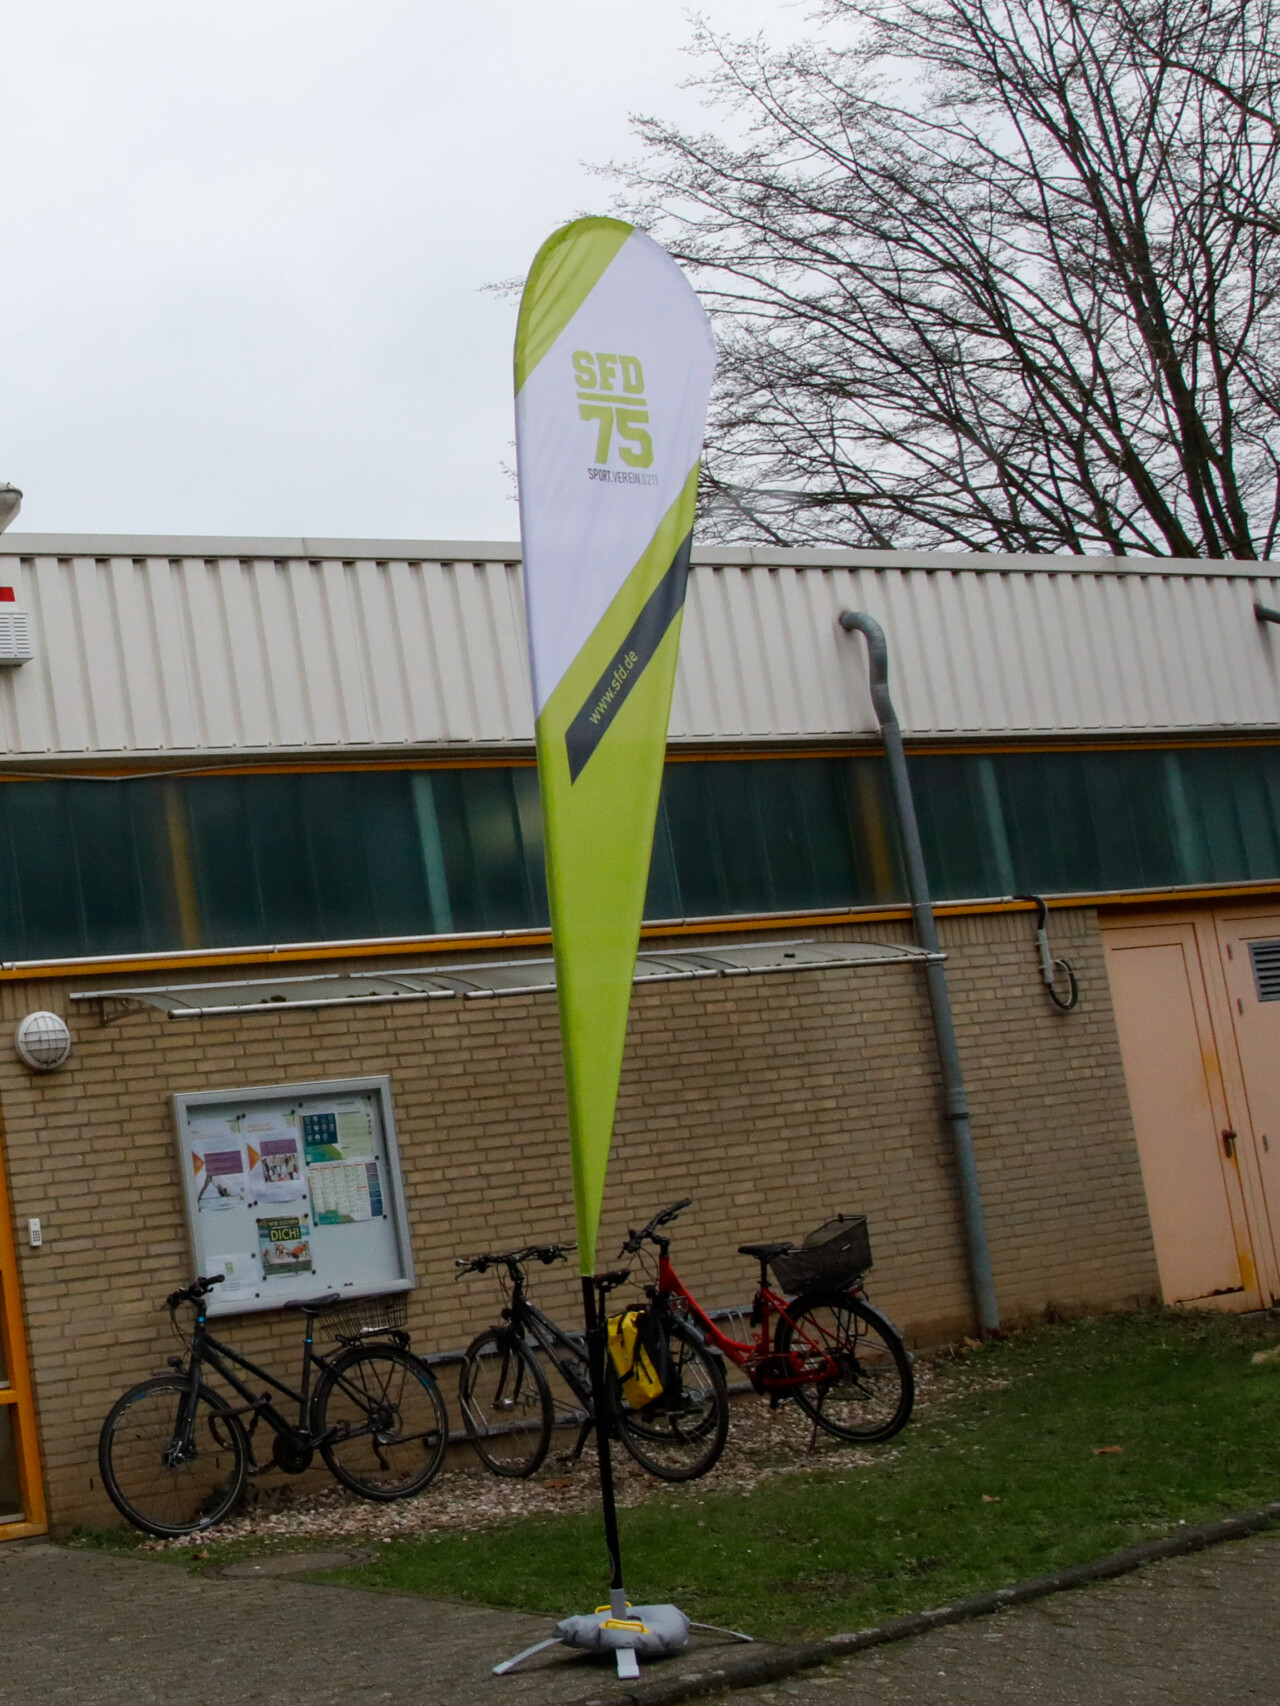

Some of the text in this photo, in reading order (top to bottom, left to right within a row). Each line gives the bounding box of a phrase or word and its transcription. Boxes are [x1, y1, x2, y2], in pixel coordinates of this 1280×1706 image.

[572, 350, 645, 395] SFD
[578, 403, 655, 469] 75
[587, 467, 659, 486] SPORT.VEREIN.0211
[589, 650, 639, 725] www.sfd.de
